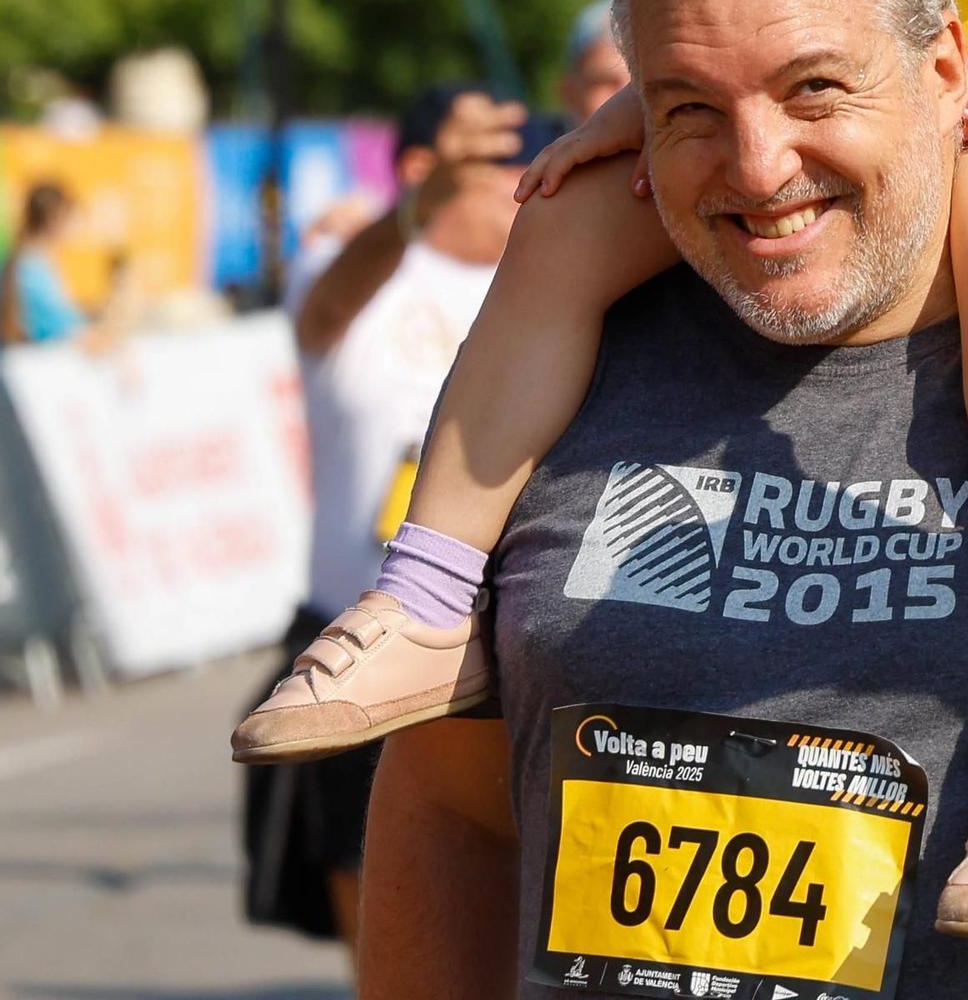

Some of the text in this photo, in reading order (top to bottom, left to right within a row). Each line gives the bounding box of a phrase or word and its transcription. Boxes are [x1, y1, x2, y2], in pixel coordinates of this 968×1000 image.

[695, 474, 736, 494] IRB
[742, 529, 963, 566] WORLD CUP
[722, 564, 956, 626] 2015
[593, 730, 709, 766] Volta a peu
[797, 745, 901, 778] QUANTES MÉS
[626, 760, 704, 782] València 2025
[791, 767, 908, 804] VOLTES MILLOR
[609, 820, 827, 947] 6784
[633, 977, 644, 986] DE
[635, 969, 682, 981] AJUNTAMENT
